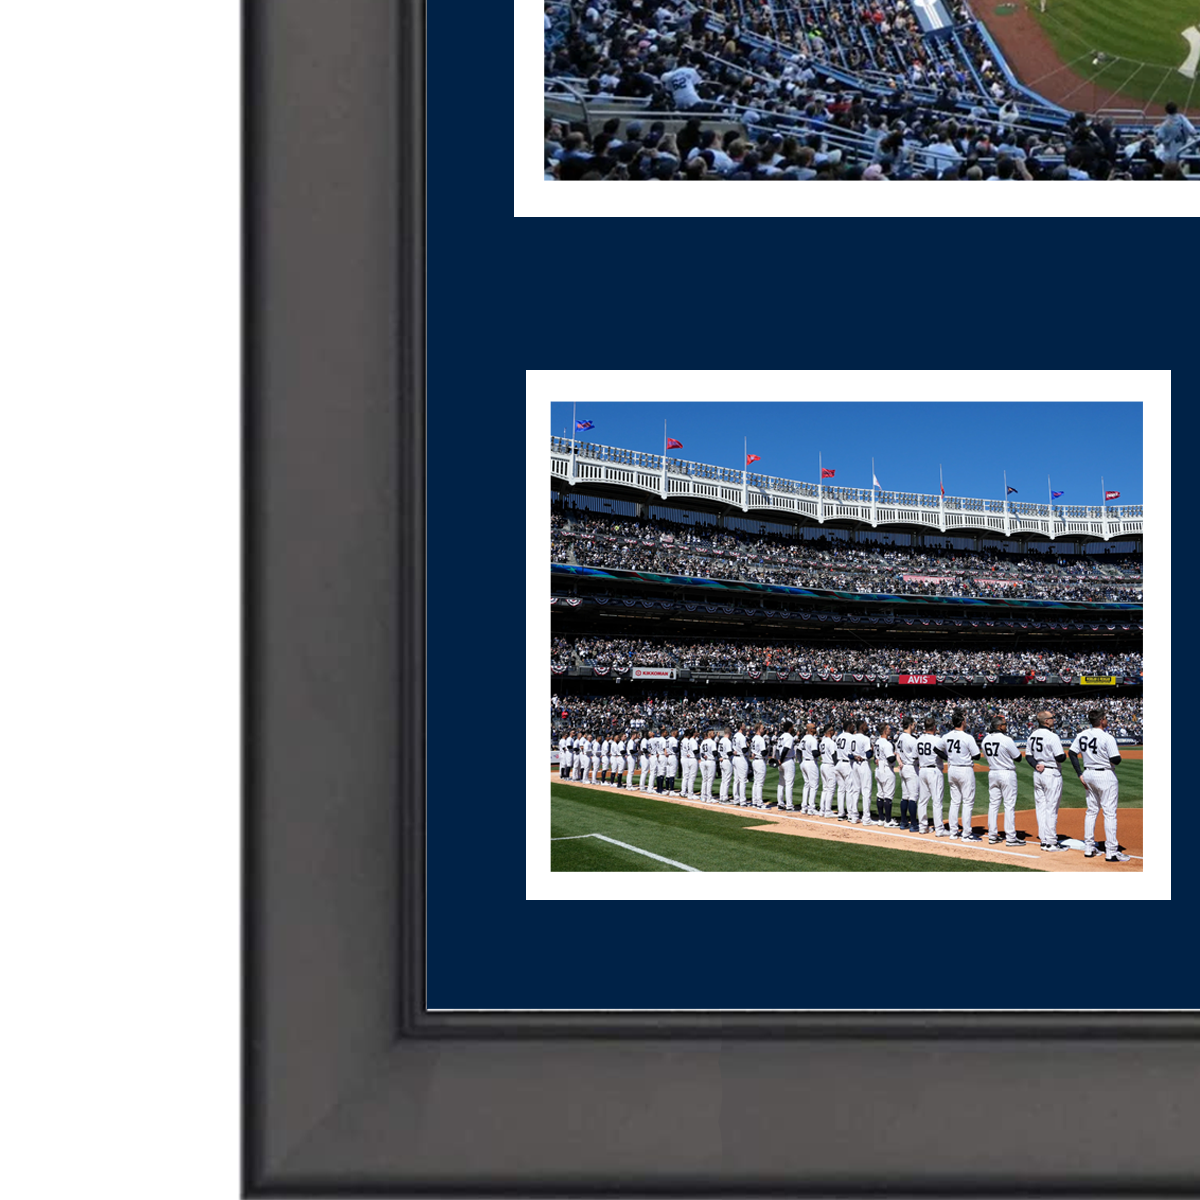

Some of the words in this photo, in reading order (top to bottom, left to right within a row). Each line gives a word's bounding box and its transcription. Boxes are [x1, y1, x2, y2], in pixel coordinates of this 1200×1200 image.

[907, 676, 928, 684] AVIS
[917, 742, 932, 756] 68
[947, 739, 961, 754] 74
[984, 742, 1000, 757] 67
[1030, 736, 1044, 753] 75
[1078, 736, 1098, 755] 64
